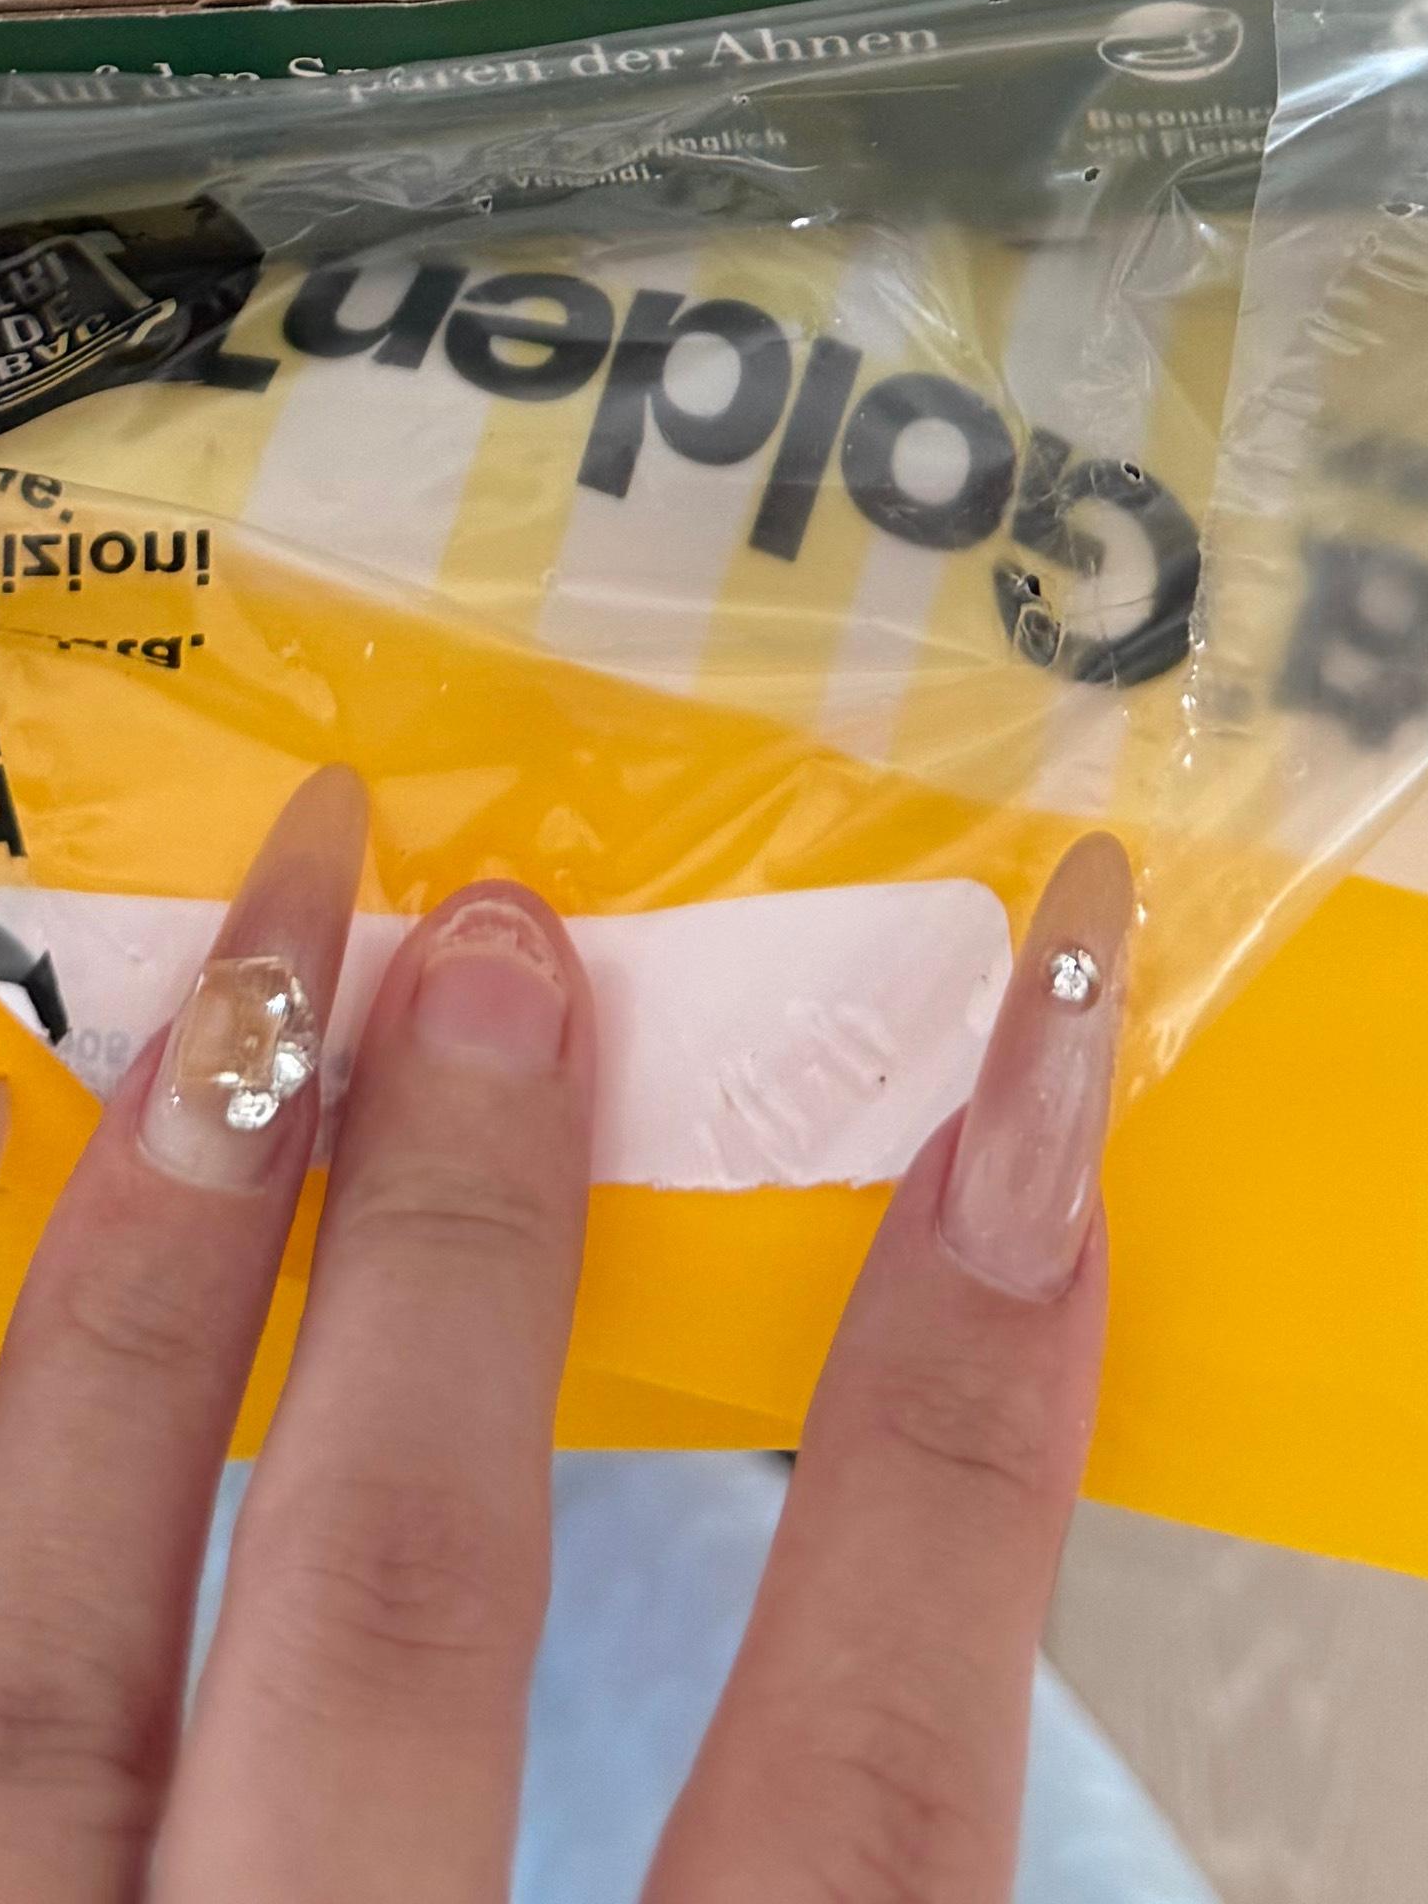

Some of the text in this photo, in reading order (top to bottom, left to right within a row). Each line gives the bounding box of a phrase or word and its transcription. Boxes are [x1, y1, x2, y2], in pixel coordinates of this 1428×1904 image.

[572, 40, 686, 78] der
[688, 26, 942, 68] Ahnen
[1156, 126, 1269, 158] Fleisc
